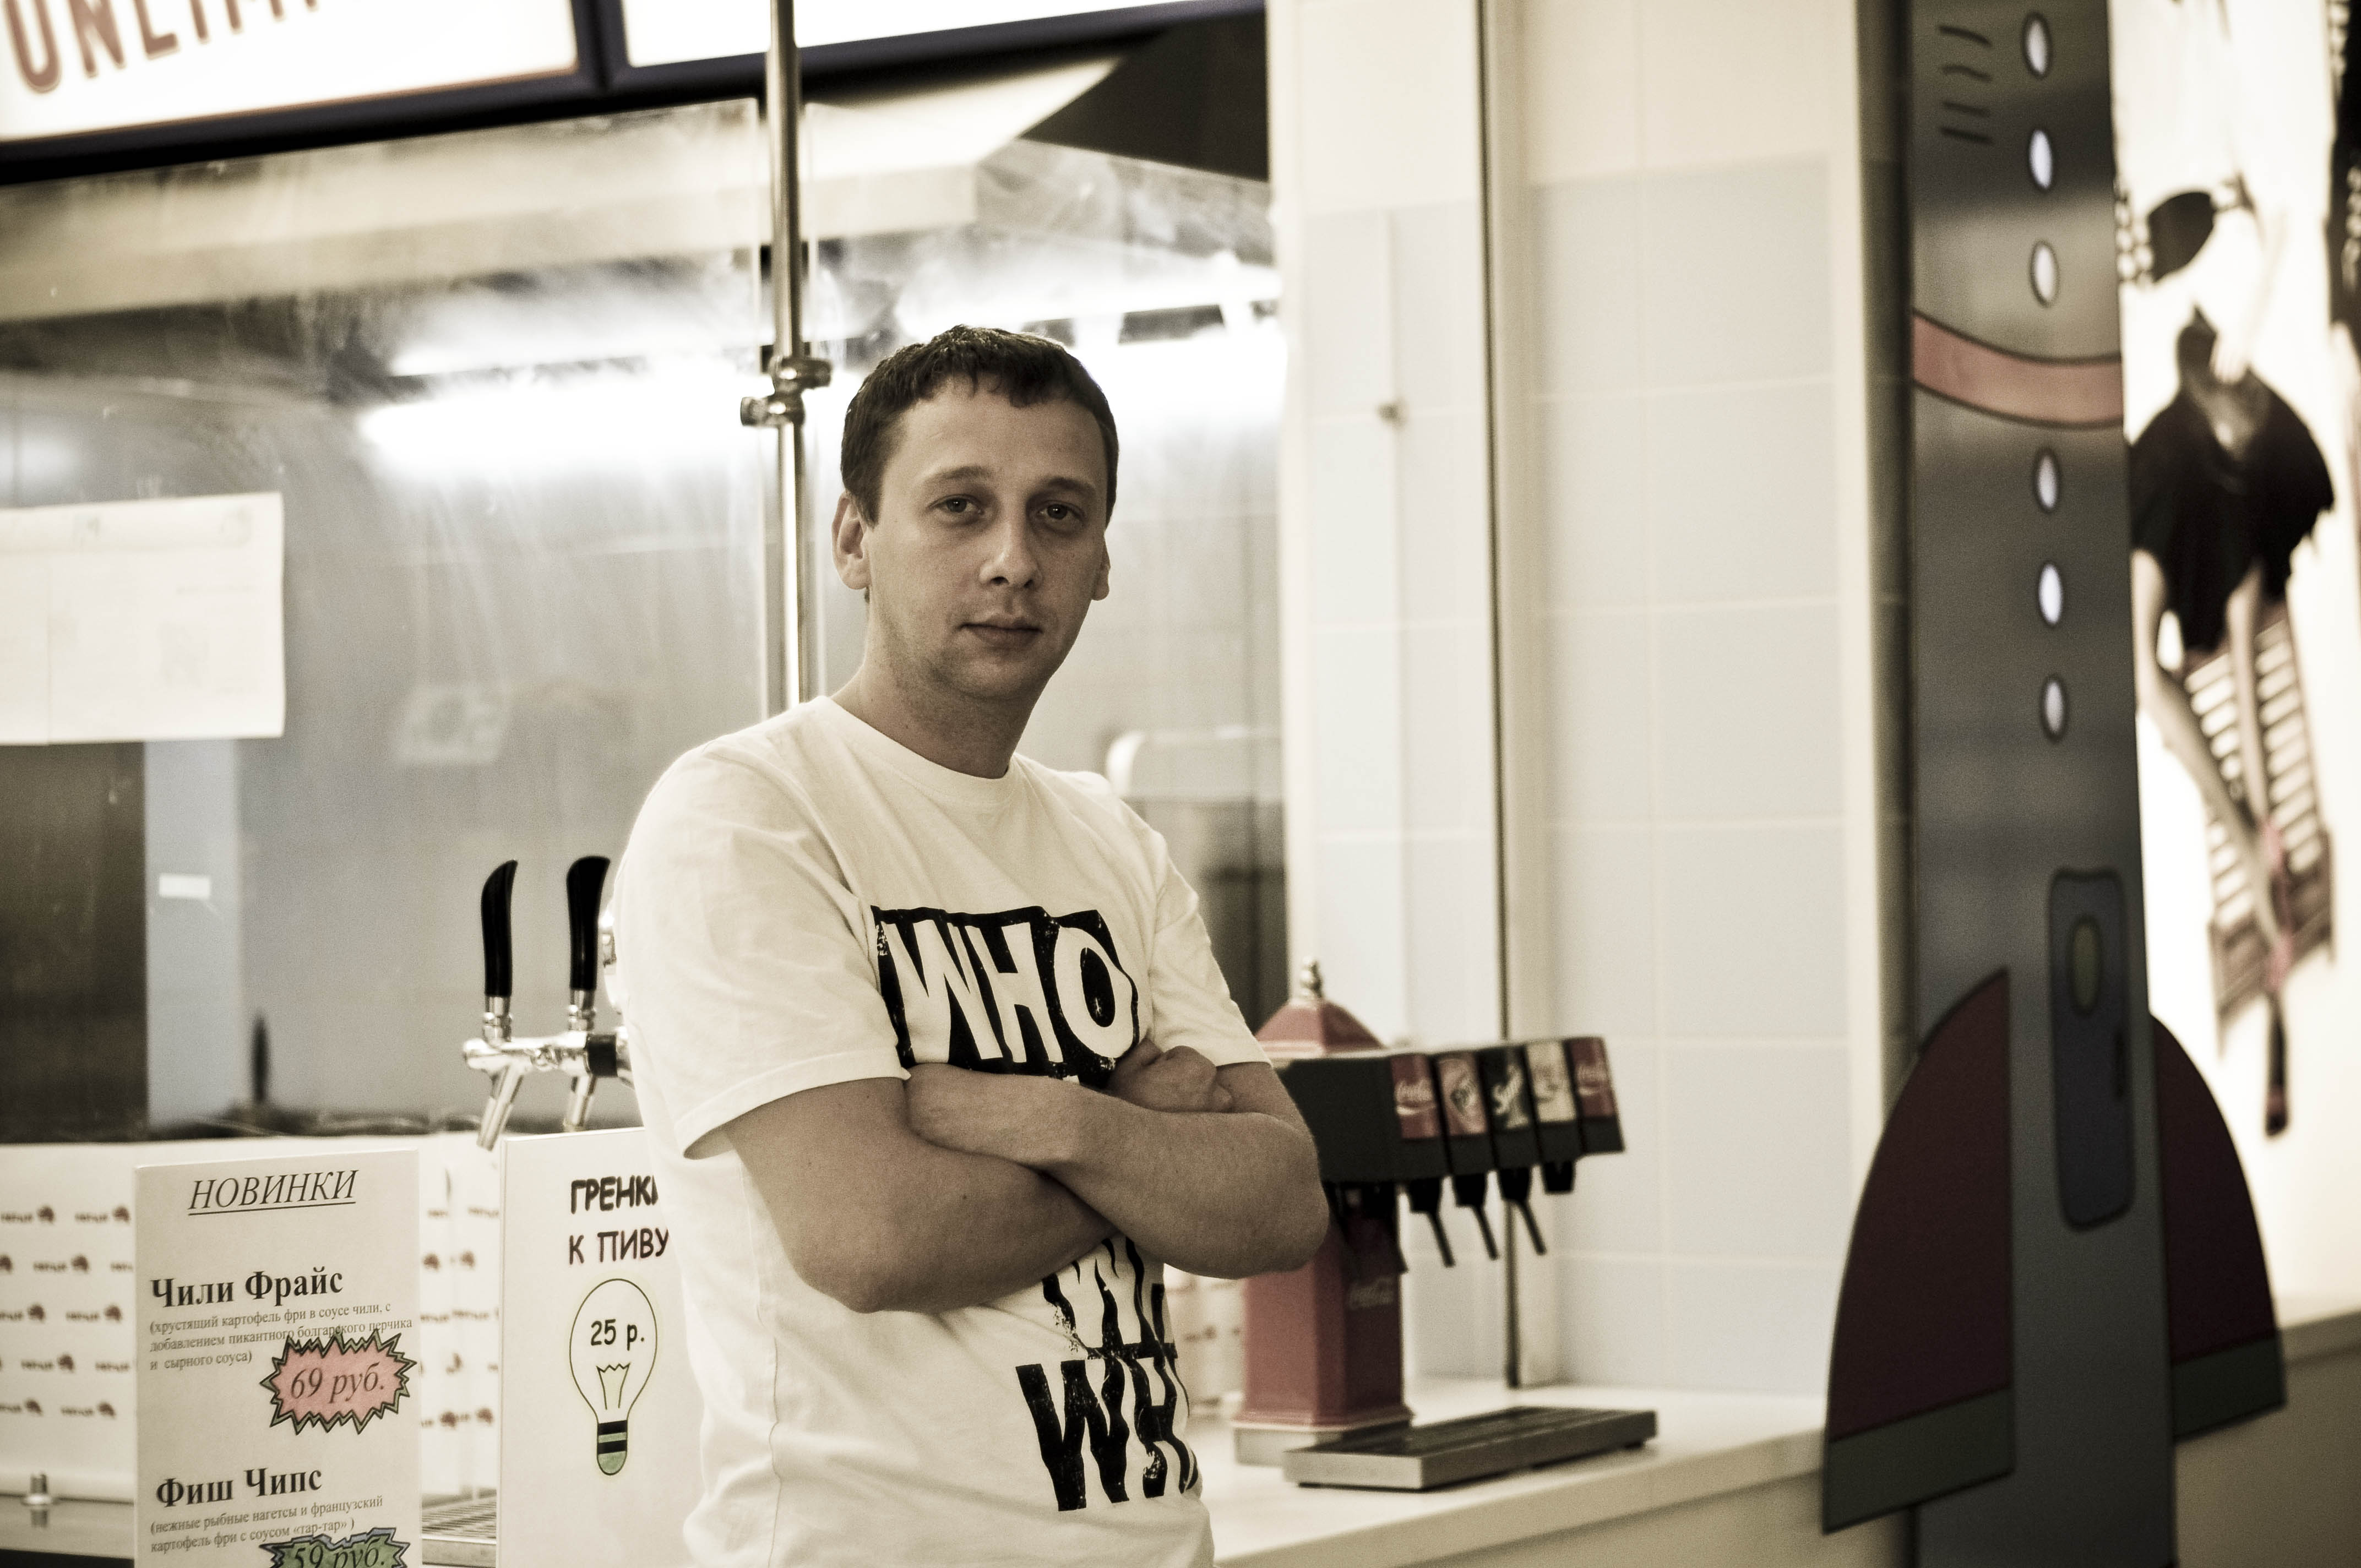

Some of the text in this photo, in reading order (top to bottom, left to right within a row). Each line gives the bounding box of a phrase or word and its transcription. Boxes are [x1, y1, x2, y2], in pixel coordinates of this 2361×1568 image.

[880, 918, 1134, 1063] WHO
[187, 1169, 359, 1210] НОВИНКИ
[569, 1227, 670, 1265] К ПИВУ
[150, 1266, 343, 1308] Чили Фрайс
[221, 1311, 281, 1329] картофель
[284, 1309, 306, 1324] фри
[309, 1310, 315, 1319] в
[319, 1306, 350, 1320] соусе
[385, 1303, 391, 1311] с
[590, 1319, 645, 1351] 25 р.
[149, 1337, 225, 1352] добавлением
[229, 1329, 294, 1344] пикантного
[369, 1319, 412, 1334] перчика
[150, 1350, 253, 1371] и сырного соуса)
[291, 1361, 384, 1403] 69 руб.
[156, 1467, 323, 1507] Фиш Чипс
[150, 1521, 200, 1536] (нежные
[203, 1512, 249, 1531] рыбные
[252, 1509, 297, 1521] нагетсы
[311, 1496, 383, 1517] французский
[151, 1536, 211, 1554] картофель
[214, 1532, 236, 1548] фри
[240, 1532, 246, 1541] с
[249, 1527, 290, 1542] соусом
[295, 1544, 323, 1568] 59
